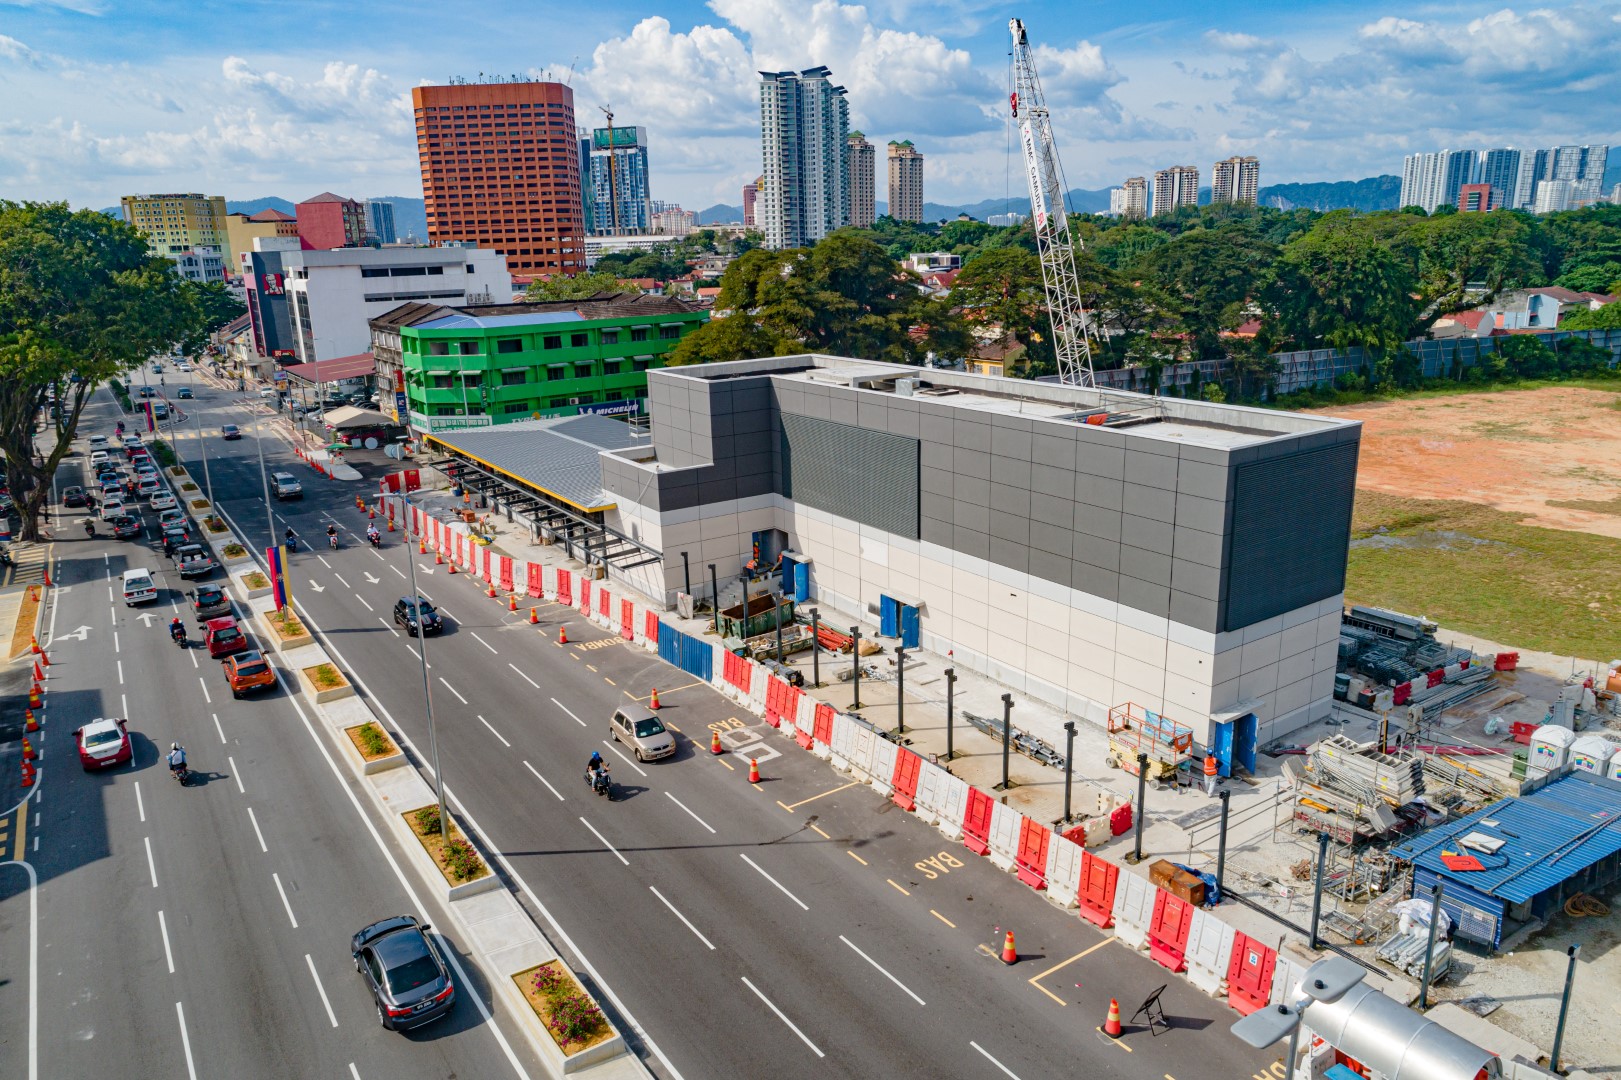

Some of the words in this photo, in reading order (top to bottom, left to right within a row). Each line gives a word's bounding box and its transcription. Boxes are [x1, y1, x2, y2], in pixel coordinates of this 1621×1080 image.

[1026, 138, 1034, 164] MMC
[1030, 167, 1041, 212] GAMUDA
[596, 404, 639, 415] MICHELIN
[574, 636, 626, 651] BOMBA
[707, 717, 746, 733] BAS
[914, 851, 965, 879] BAS
